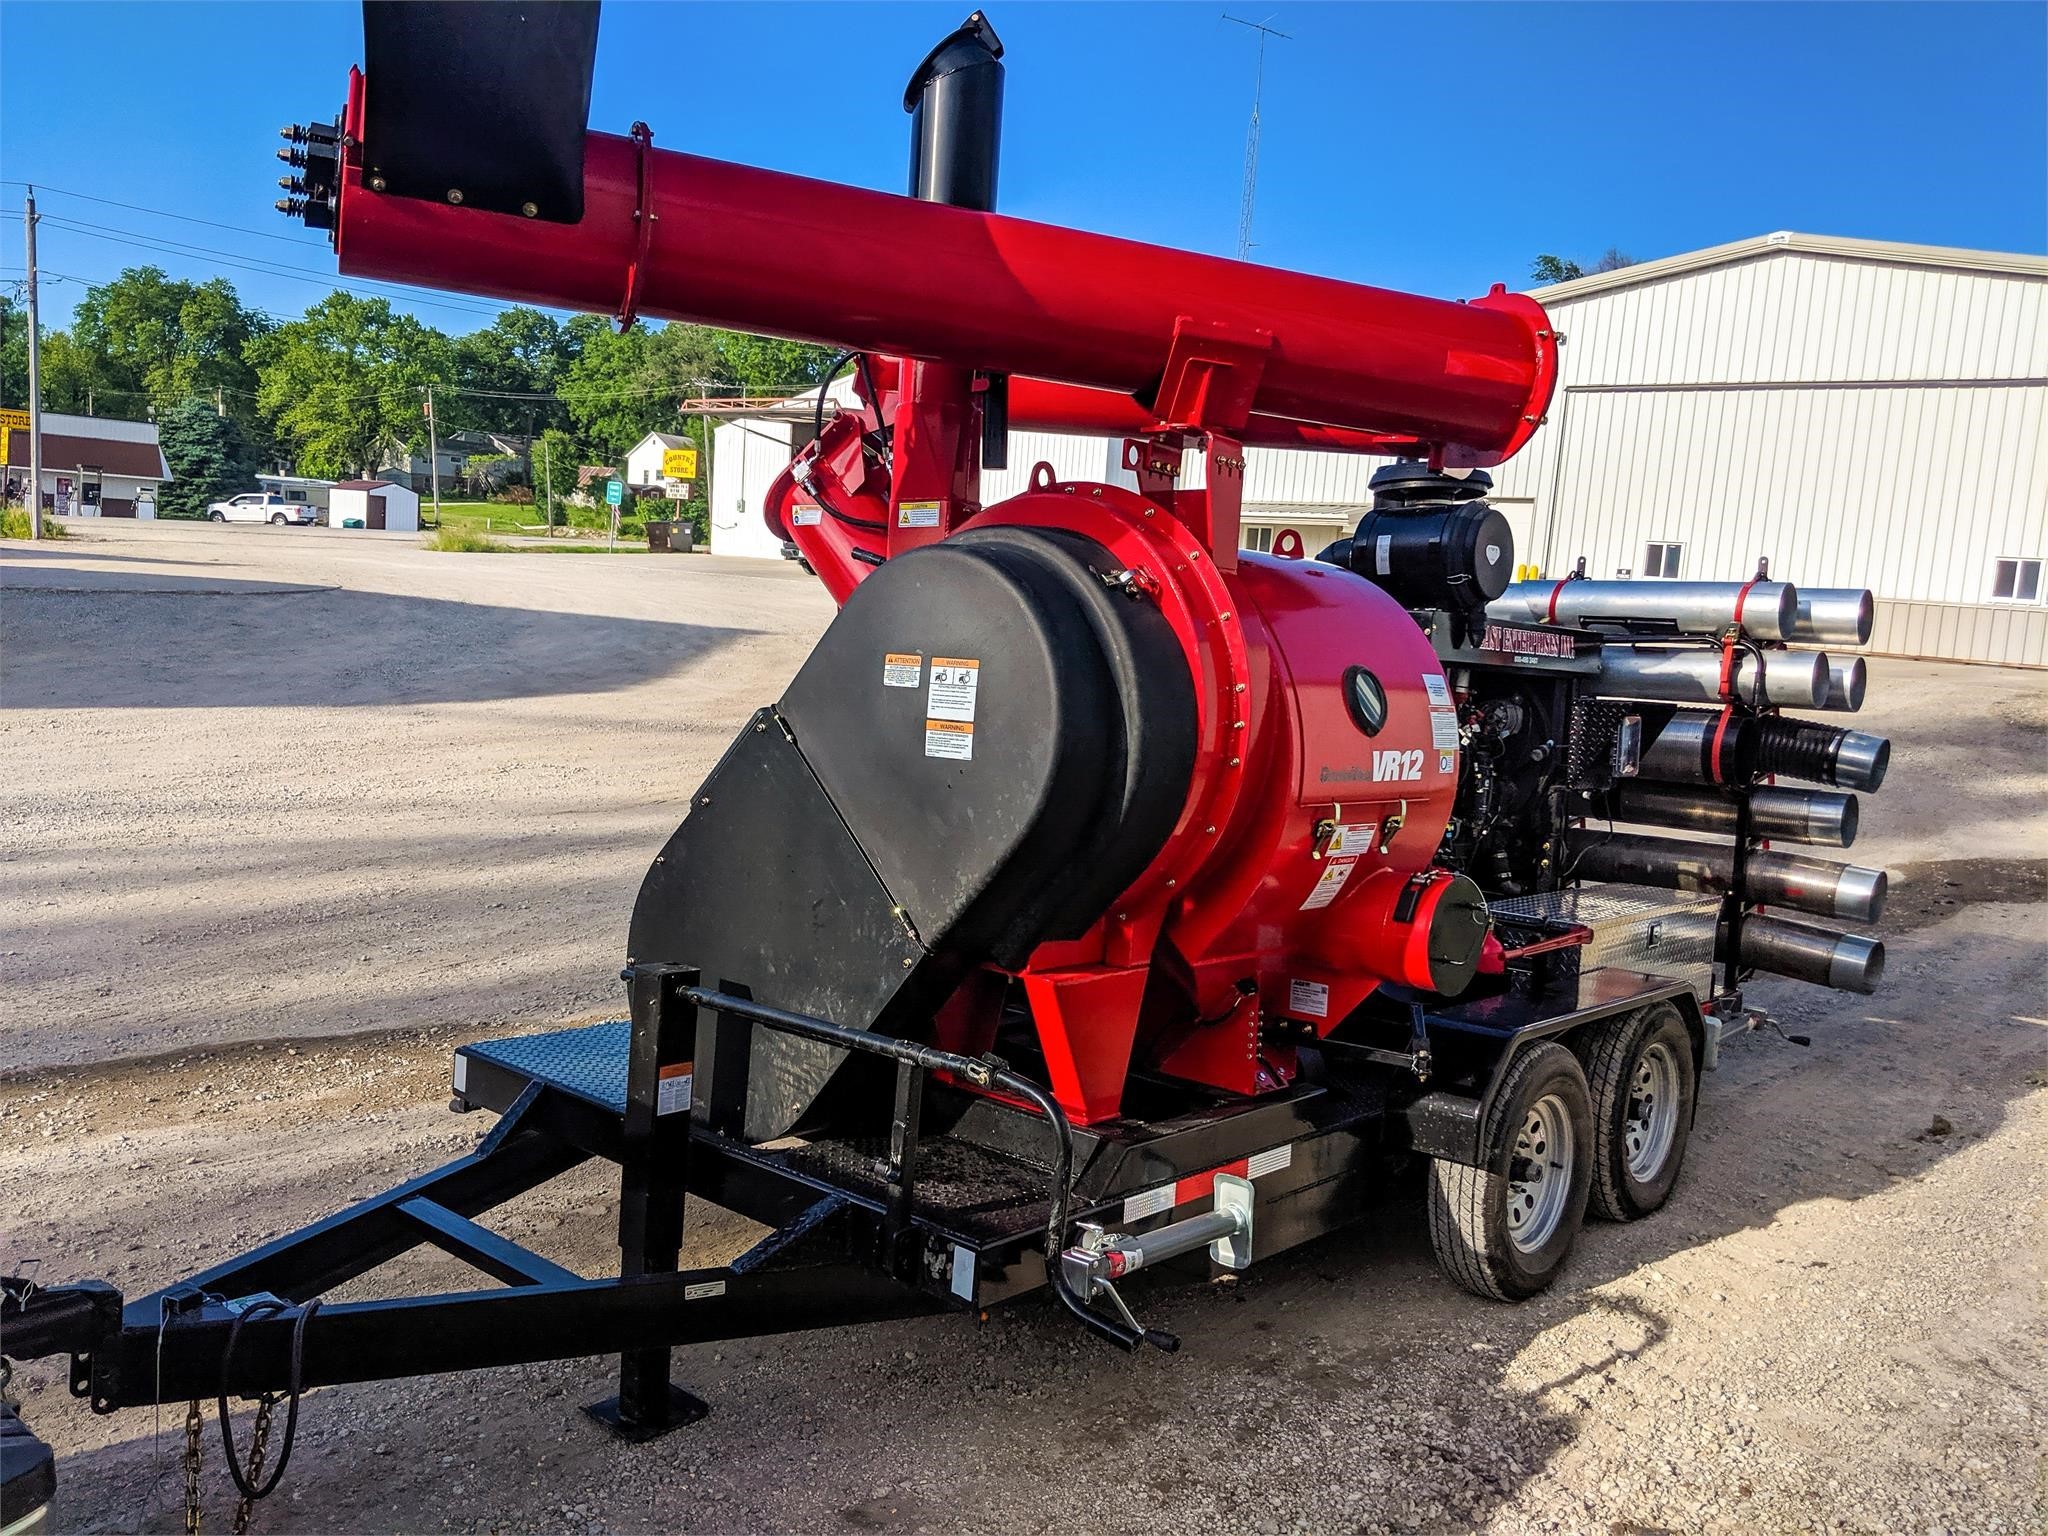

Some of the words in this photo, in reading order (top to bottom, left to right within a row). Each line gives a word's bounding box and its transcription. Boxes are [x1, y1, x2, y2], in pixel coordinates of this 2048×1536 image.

[0, 414, 31, 426] STORE
[665, 454, 694, 466] COUNTRY
[1502, 627, 1559, 657] ENTERPRISES
[894, 657, 920, 665] ATTENTION
[940, 723, 965, 731] WARNING
[1372, 749, 1424, 782] VR12
